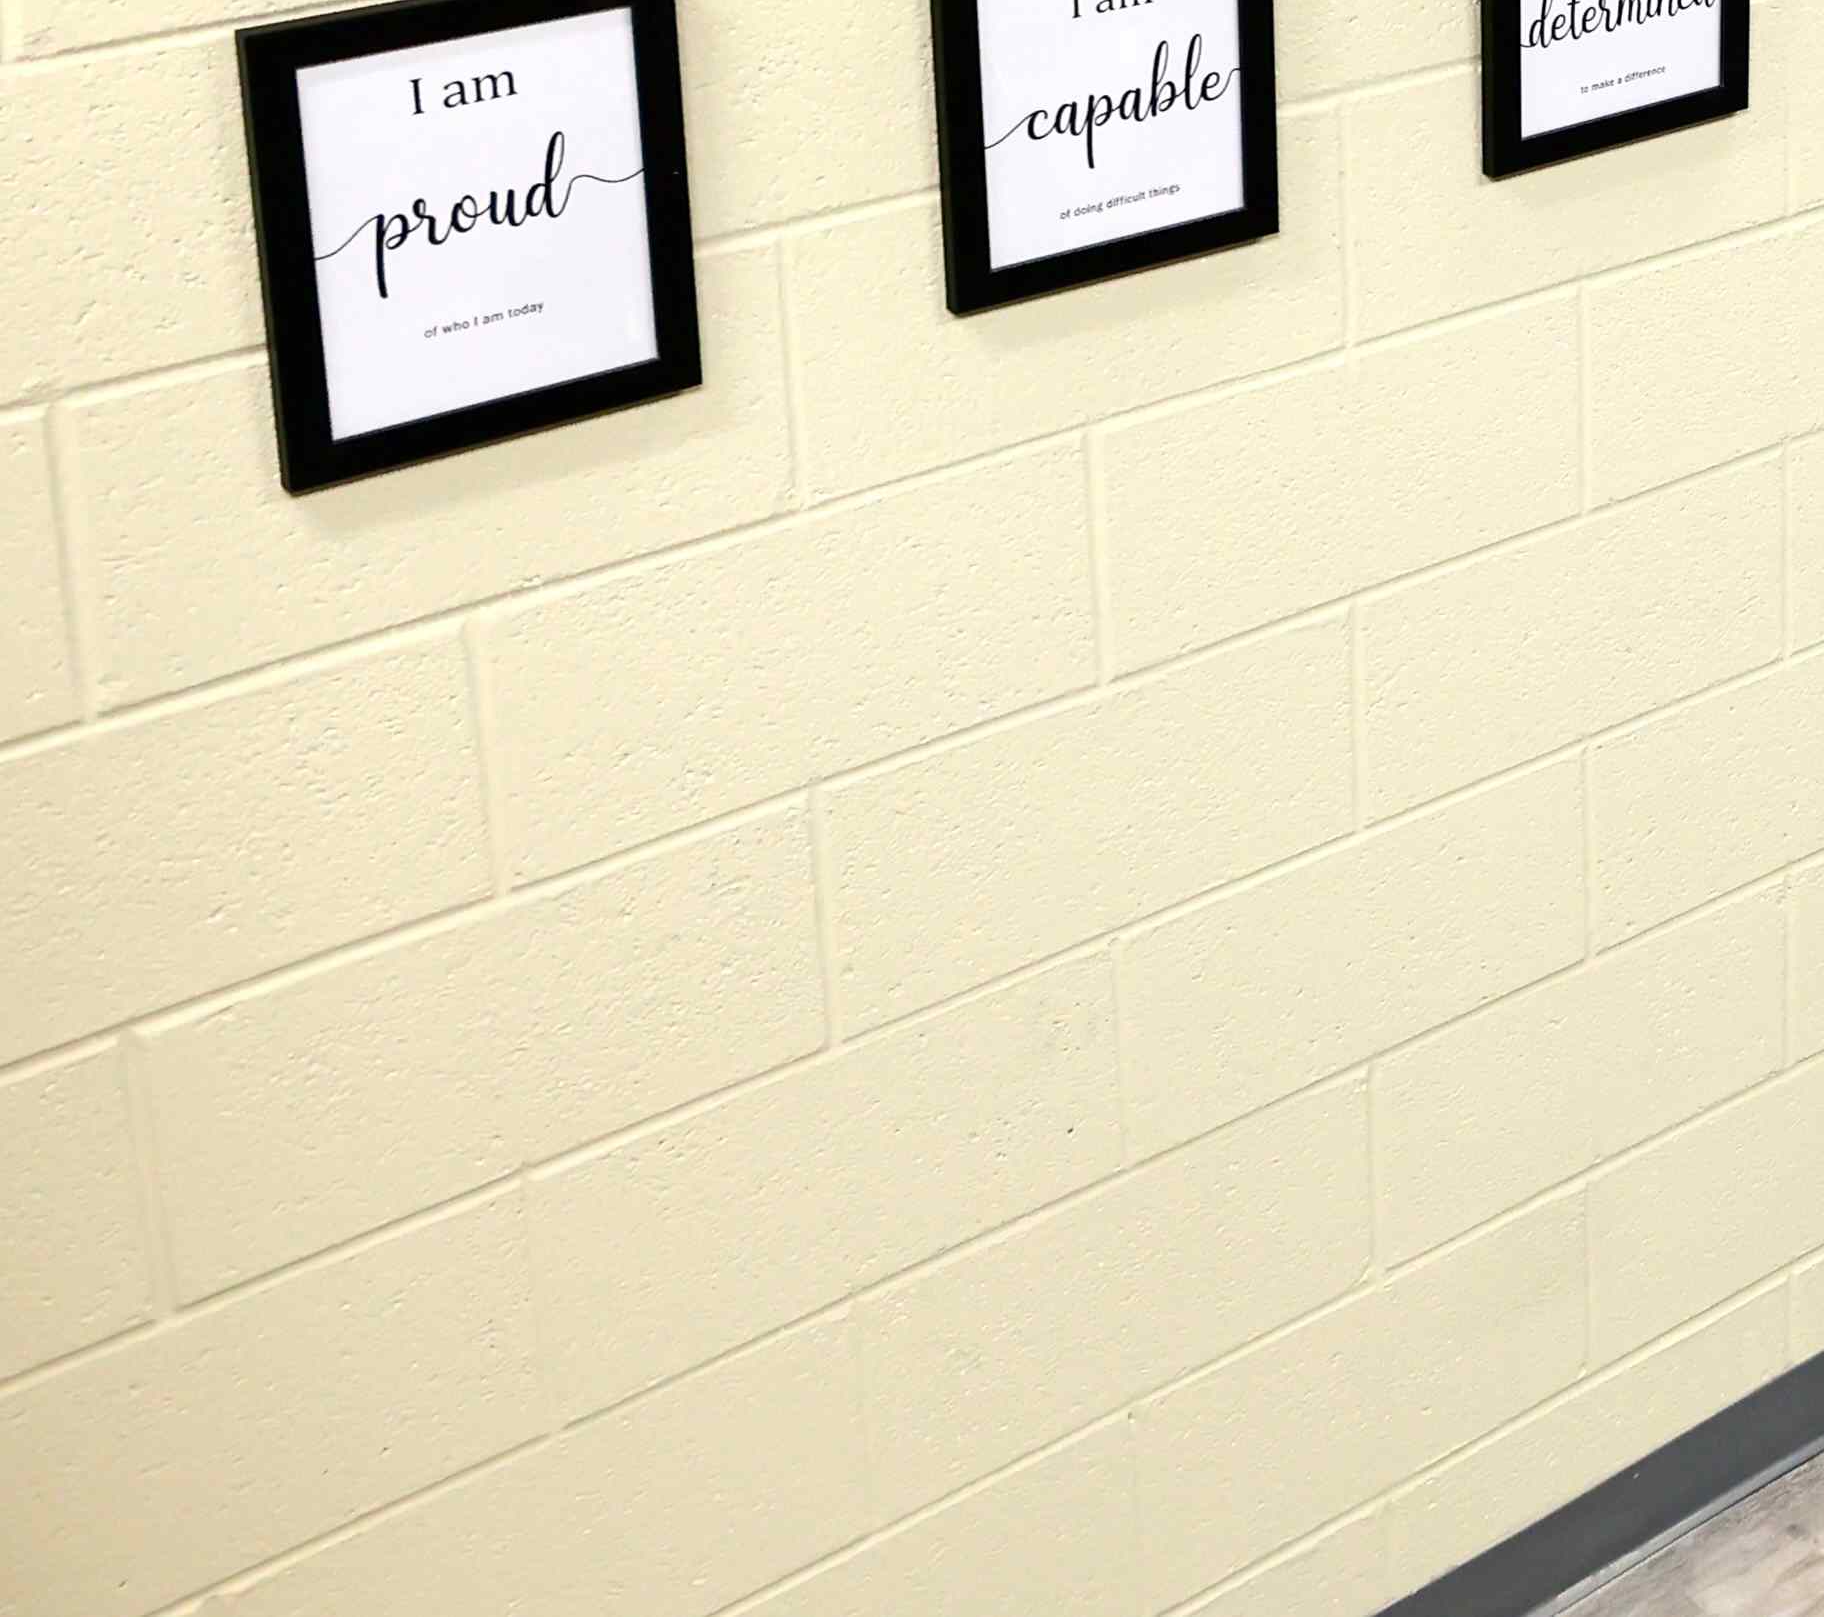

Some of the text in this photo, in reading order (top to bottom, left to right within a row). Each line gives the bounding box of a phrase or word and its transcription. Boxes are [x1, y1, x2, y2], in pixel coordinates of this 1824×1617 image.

[410, 70, 517, 115] I am
[1580, 84, 1589, 94] to
[1592, 77, 1615, 90] make
[1624, 64, 1666, 84] difference
[1017, 33, 1235, 168] capable
[363, 131, 576, 298] proud
[1059, 183, 1181, 220] of doing difficult things
[424, 326, 438, 338] of
[443, 319, 470, 335] who
[482, 310, 504, 324] am
[507, 302, 545, 320] today
